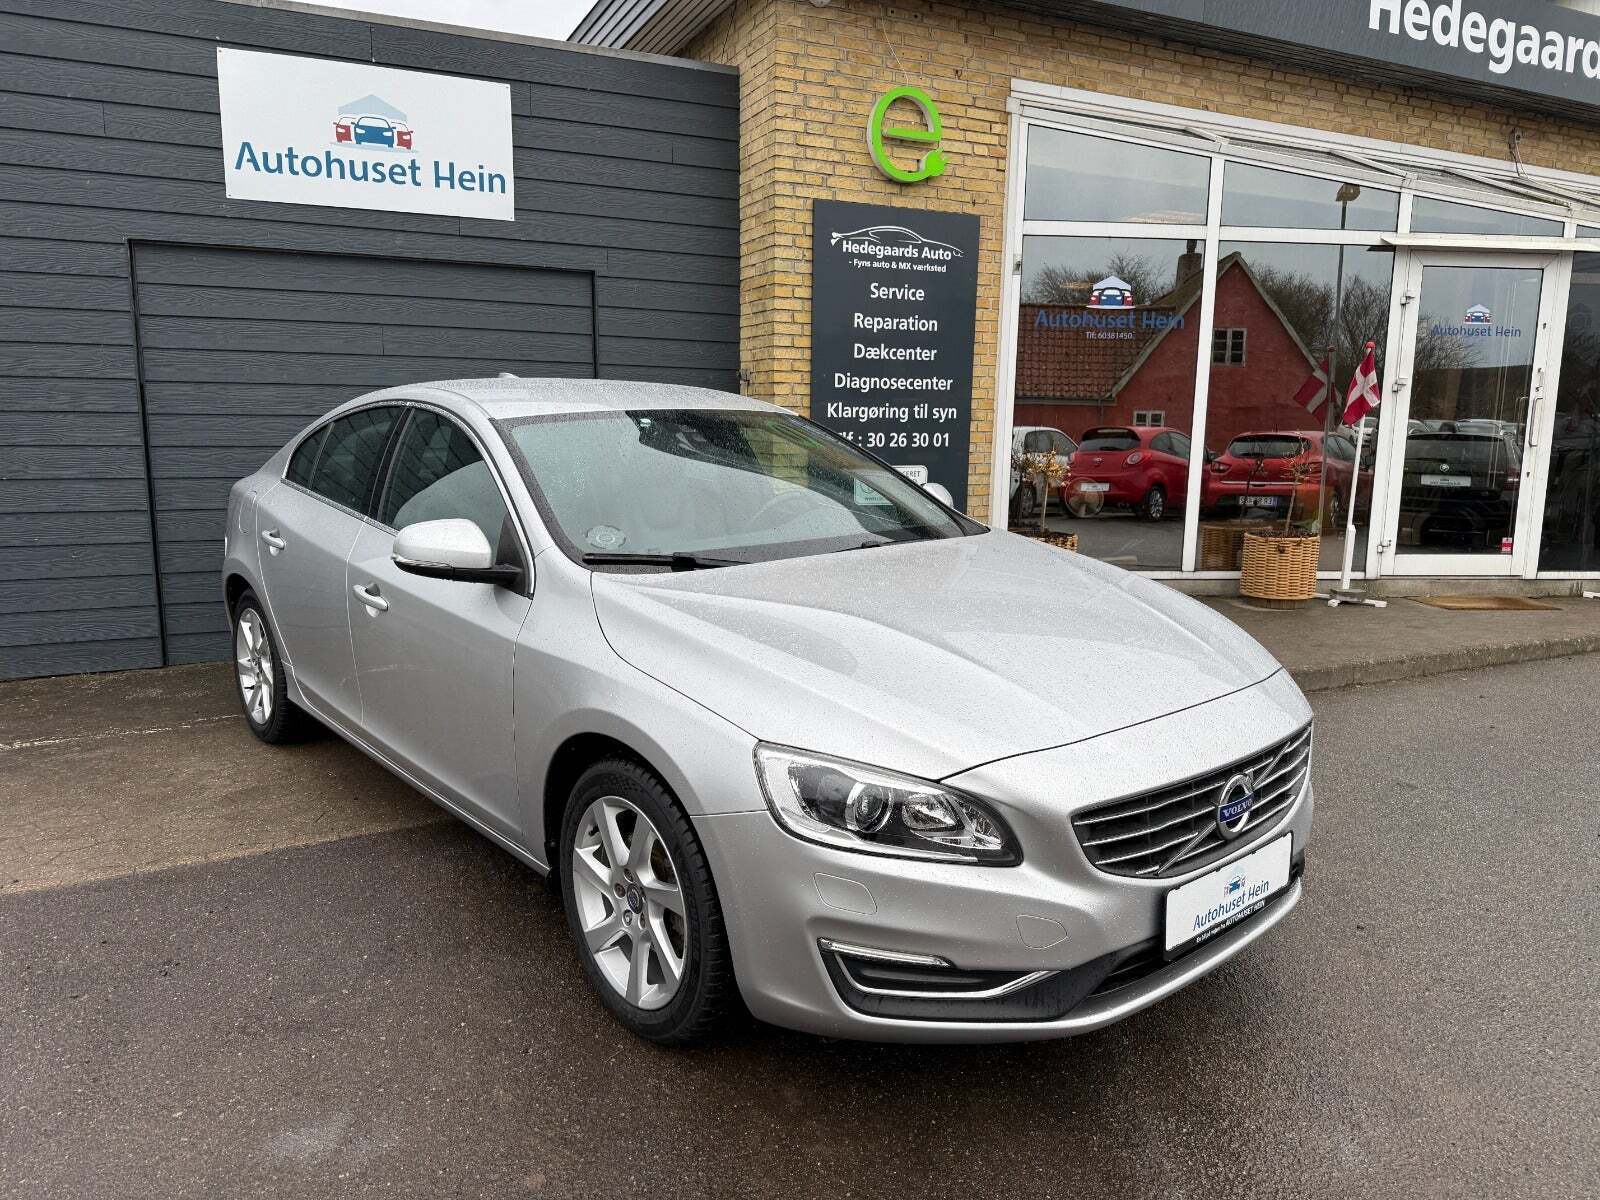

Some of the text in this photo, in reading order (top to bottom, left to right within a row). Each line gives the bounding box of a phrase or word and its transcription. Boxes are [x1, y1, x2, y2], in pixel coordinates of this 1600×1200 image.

[234, 141, 507, 194] Autohuset Hein
[842, 240, 952, 260] Hedegaards Auto
[853, 258, 871, 269] Fyns
[872, 261, 890, 269] auto
[891, 261, 897, 269] &
[898, 261, 912, 270] MX
[870, 282, 925, 301] Service
[854, 312, 938, 332] Reparation
[1035, 309, 1185, 329] Autohuset Hein
[1431, 324, 1522, 337] Autohuset Hein
[854, 343, 937, 361] Dækcenter
[834, 372, 953, 393] Diagnosecenter
[827, 402, 957, 423] Klargøring til syn
[867, 432, 885, 447] 30
[889, 432, 907, 448] 26
[911, 432, 929, 448] 30
[933, 432, 950, 448] 01
[1222, 798, 1252, 818] VOLVO
[1193, 879, 1269, 932] Autohuset Hein
